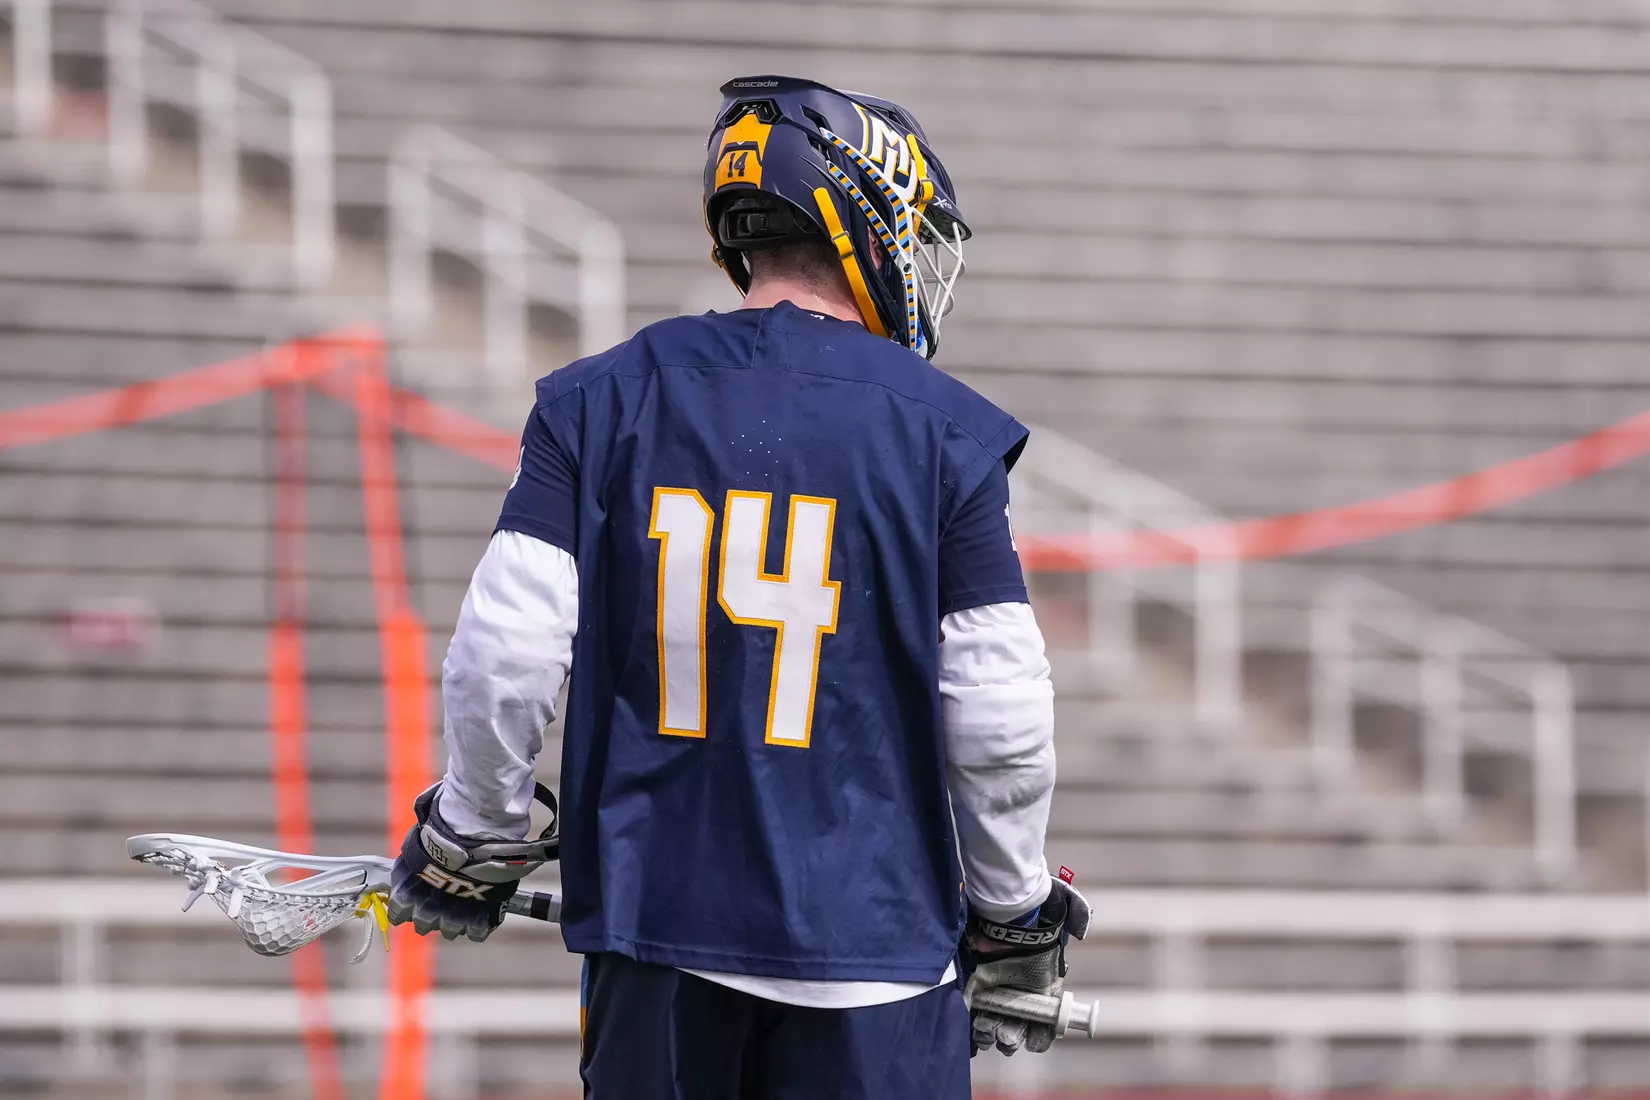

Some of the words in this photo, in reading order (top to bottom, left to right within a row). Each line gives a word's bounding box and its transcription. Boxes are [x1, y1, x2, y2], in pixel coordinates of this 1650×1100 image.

[732, 80, 779, 88] cascade
[727, 151, 747, 178] 14
[648, 486, 842, 749] 14
[417, 863, 494, 901] STX
[1060, 867, 1073, 880] STX
